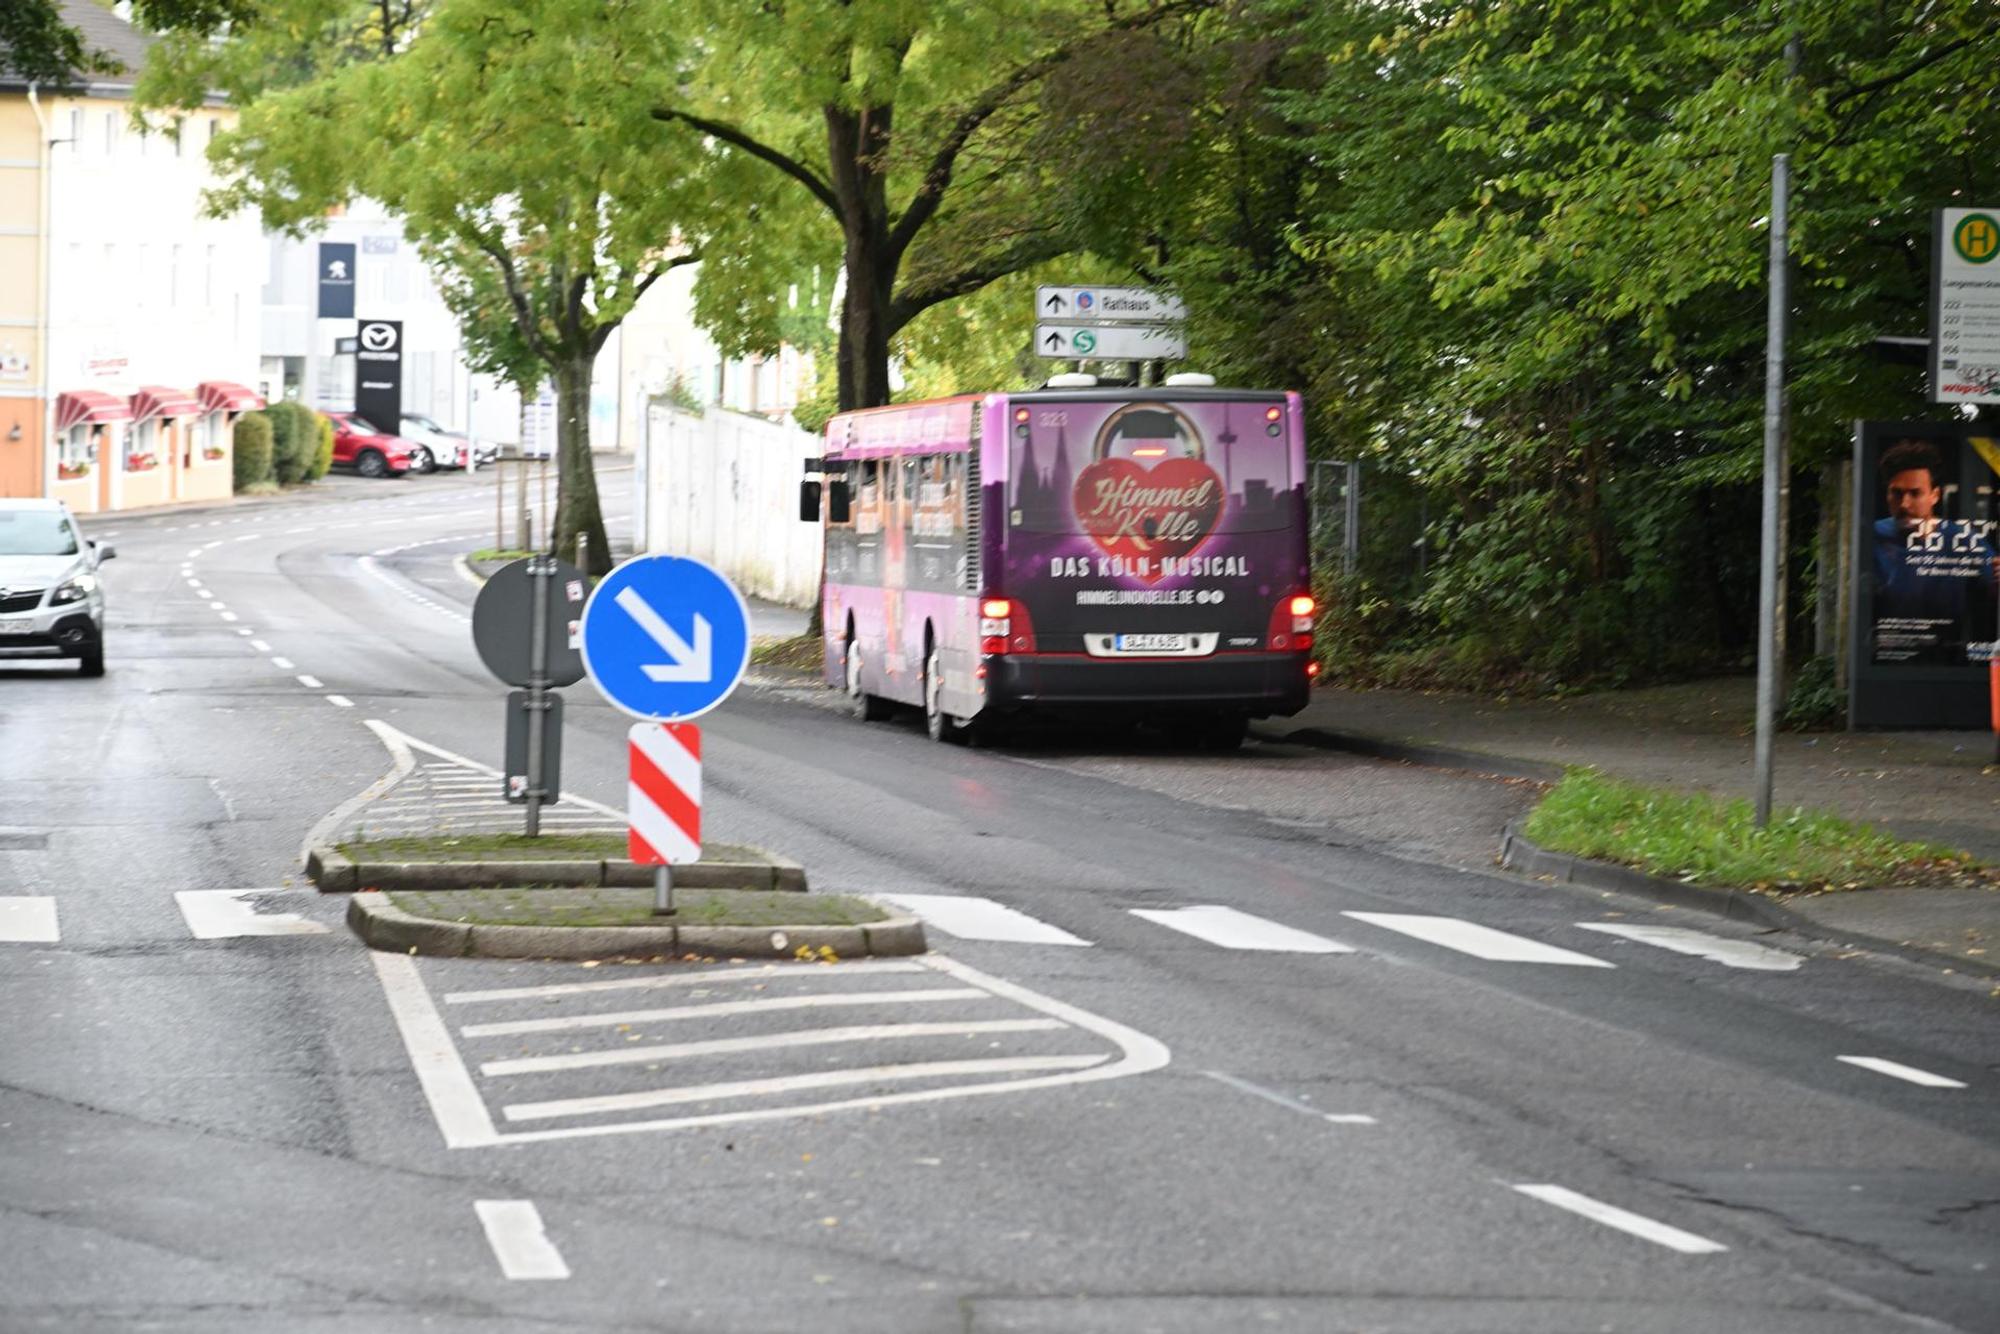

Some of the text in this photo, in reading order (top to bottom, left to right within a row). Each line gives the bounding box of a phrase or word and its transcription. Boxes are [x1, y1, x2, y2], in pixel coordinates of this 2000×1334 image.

[1967, 226, 1989, 254] H
[1102, 297, 1150, 311] Rathaus
[1091, 476, 1214, 516] Himmel
[1050, 554, 1250, 578] DAS KÖLN-MUSICAL
